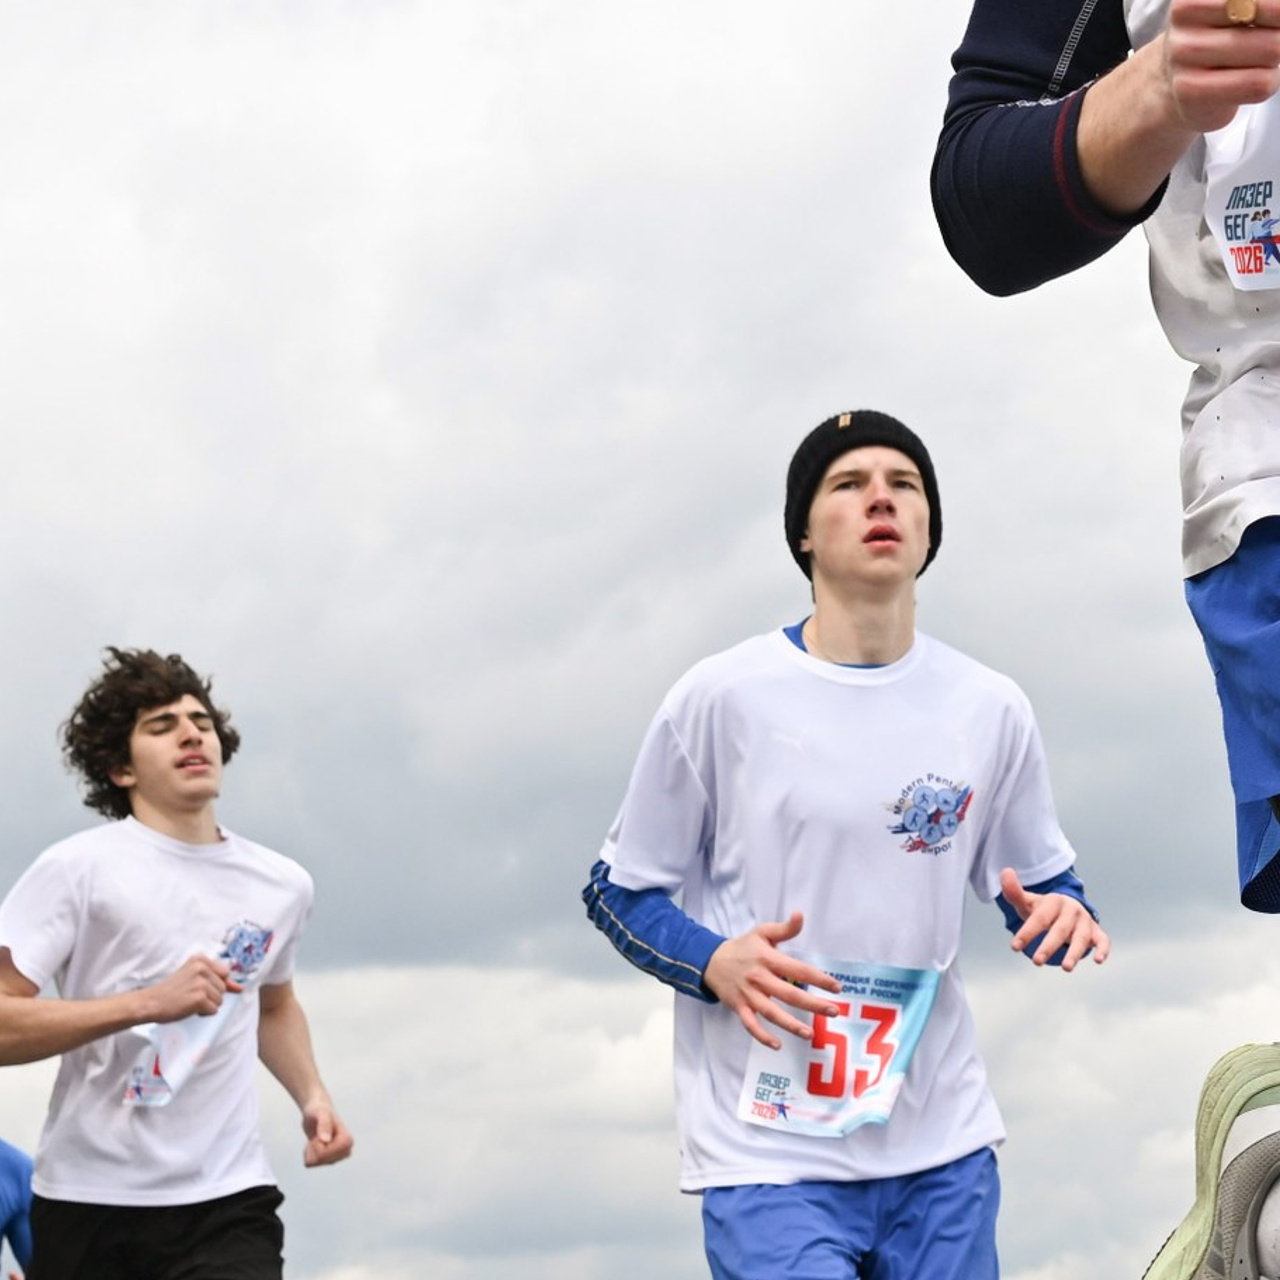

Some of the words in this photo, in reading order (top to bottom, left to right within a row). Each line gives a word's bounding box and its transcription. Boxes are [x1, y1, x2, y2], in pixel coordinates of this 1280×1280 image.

[1225, 181, 1273, 210] ЛАЗЕР
[1224, 214, 1249, 241] БЕГ
[807, 1001, 898, 1098] 53
[758, 1072, 791, 1090] ЛАЗЕР
[755, 1086, 772, 1102] БЕГ
[751, 1102, 777, 1120] 2026
